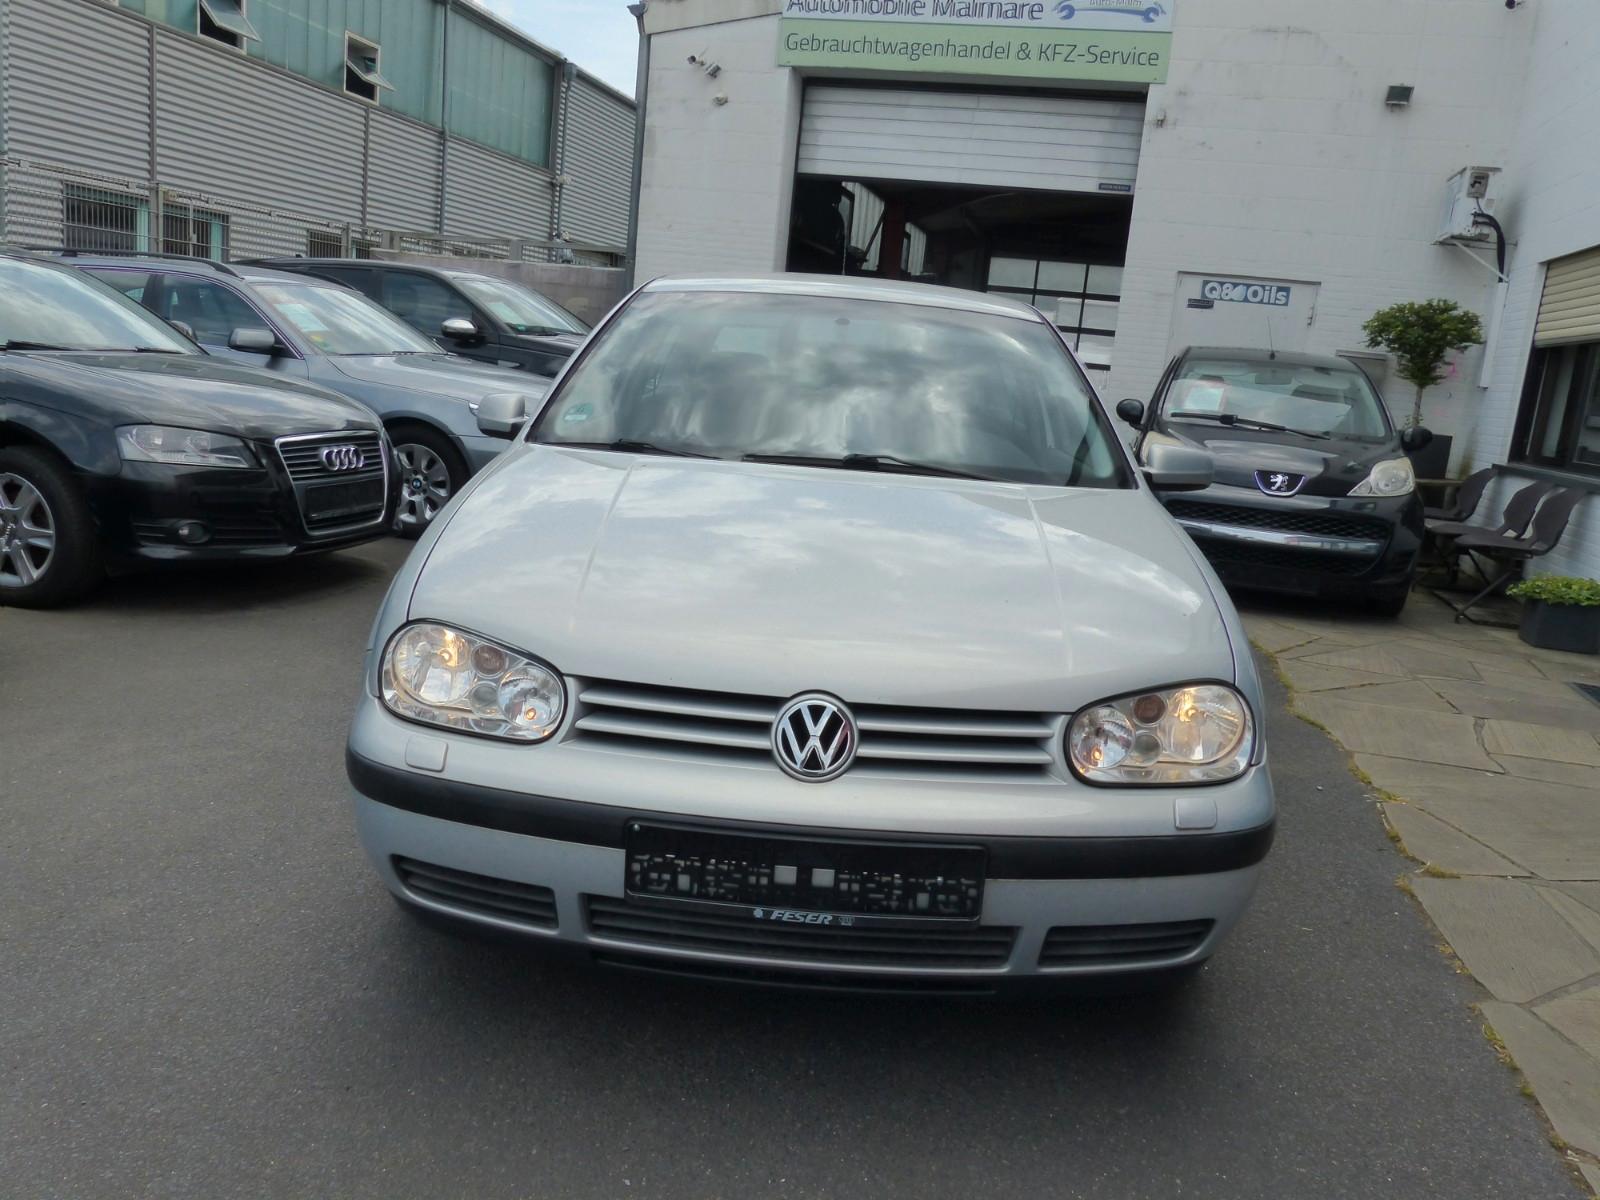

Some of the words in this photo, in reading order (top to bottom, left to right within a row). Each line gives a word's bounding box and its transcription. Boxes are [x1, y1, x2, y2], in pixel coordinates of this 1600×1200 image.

[786, 32, 1011, 61] Gebrauchtwagenhandel
[1016, 42, 1032, 61] &
[1038, 43, 1160, 66] KFZ-Service
[1247, 285, 1288, 305] Oils
[769, 910, 833, 925] FESER
